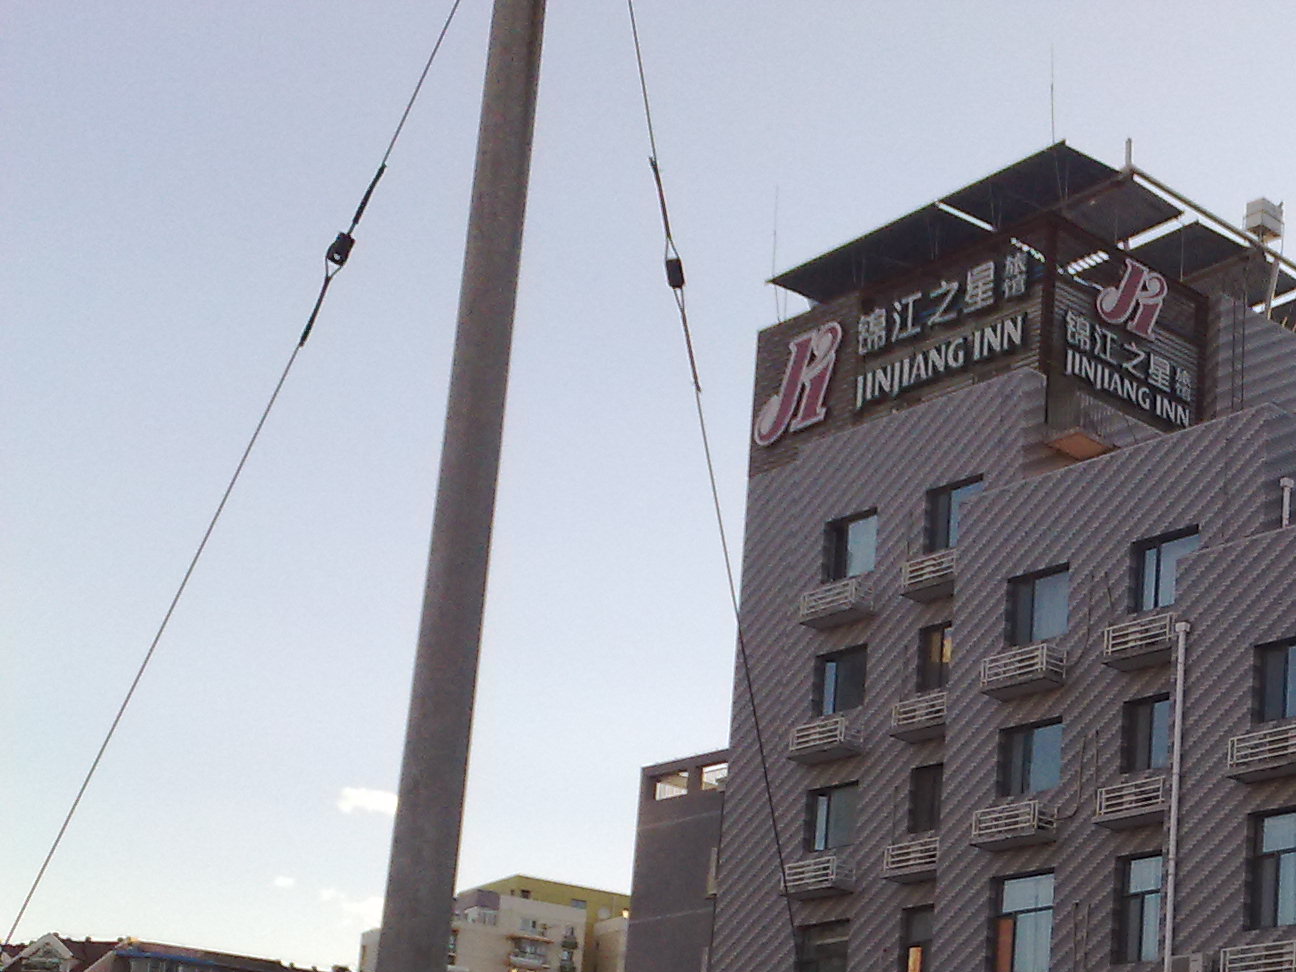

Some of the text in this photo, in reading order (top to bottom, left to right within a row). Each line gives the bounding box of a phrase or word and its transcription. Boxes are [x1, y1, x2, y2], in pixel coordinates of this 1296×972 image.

[858, 260, 995, 356] 锦江之星
[1065, 309, 1171, 393] 锦江之星
[856, 316, 1024, 410] JINJIANG INN
[1065, 350, 1190, 428] JINJIANG INN
